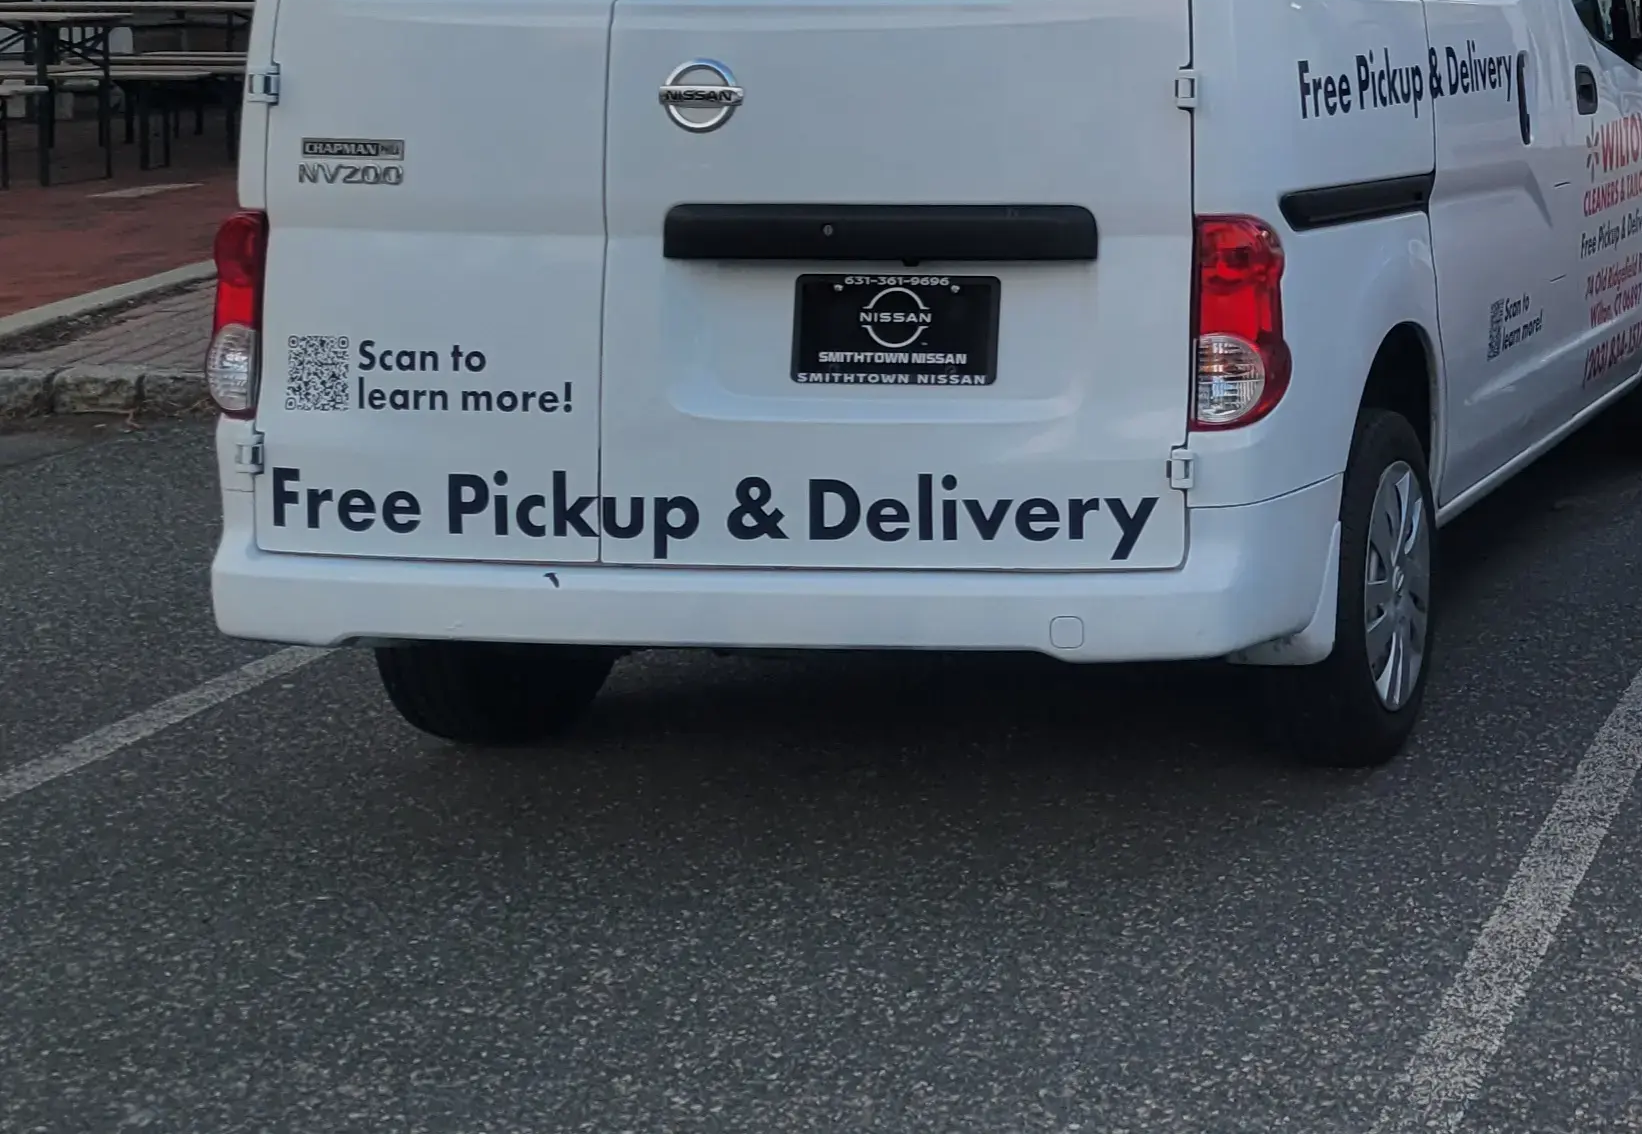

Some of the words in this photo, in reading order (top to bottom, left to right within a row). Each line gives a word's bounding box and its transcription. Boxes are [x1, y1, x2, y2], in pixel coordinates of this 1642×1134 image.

[1298, 60, 1352, 120] Free
[1355, 47, 1424, 119] Pickup
[1428, 46, 1446, 100] &
[1445, 39, 1512, 103] Delivery
[665, 90, 732, 102] NISSAN
[304, 142, 377, 155] CHAPMAN
[299, 164, 404, 186] NV200
[1584, 181, 1619, 216] CLEANERS
[1580, 232, 1597, 258] Free
[1598, 219, 1619, 251] Pickup
[844, 277, 950, 287] 631-361-9696
[859, 312, 932, 323] NISSAN
[1504, 297, 1522, 322] Scan
[1523, 292, 1530, 312] to
[1502, 326, 1521, 352] learn
[1522, 307, 1543, 342] more!
[357, 339, 439, 371] Scan
[451, 345, 487, 372] to
[818, 351, 910, 364] SMITHTOWN
[911, 352, 968, 365] NISSAN
[796, 372, 910, 385] SMITHTOWN
[917, 373, 987, 385] NISSAN
[358, 376, 449, 411] learn
[461, 381, 573, 413] more!
[272, 468, 423, 534] Free
[447, 471, 700, 559] Pickup
[727, 476, 789, 540] &
[808, 474, 1159, 561] Delivery
